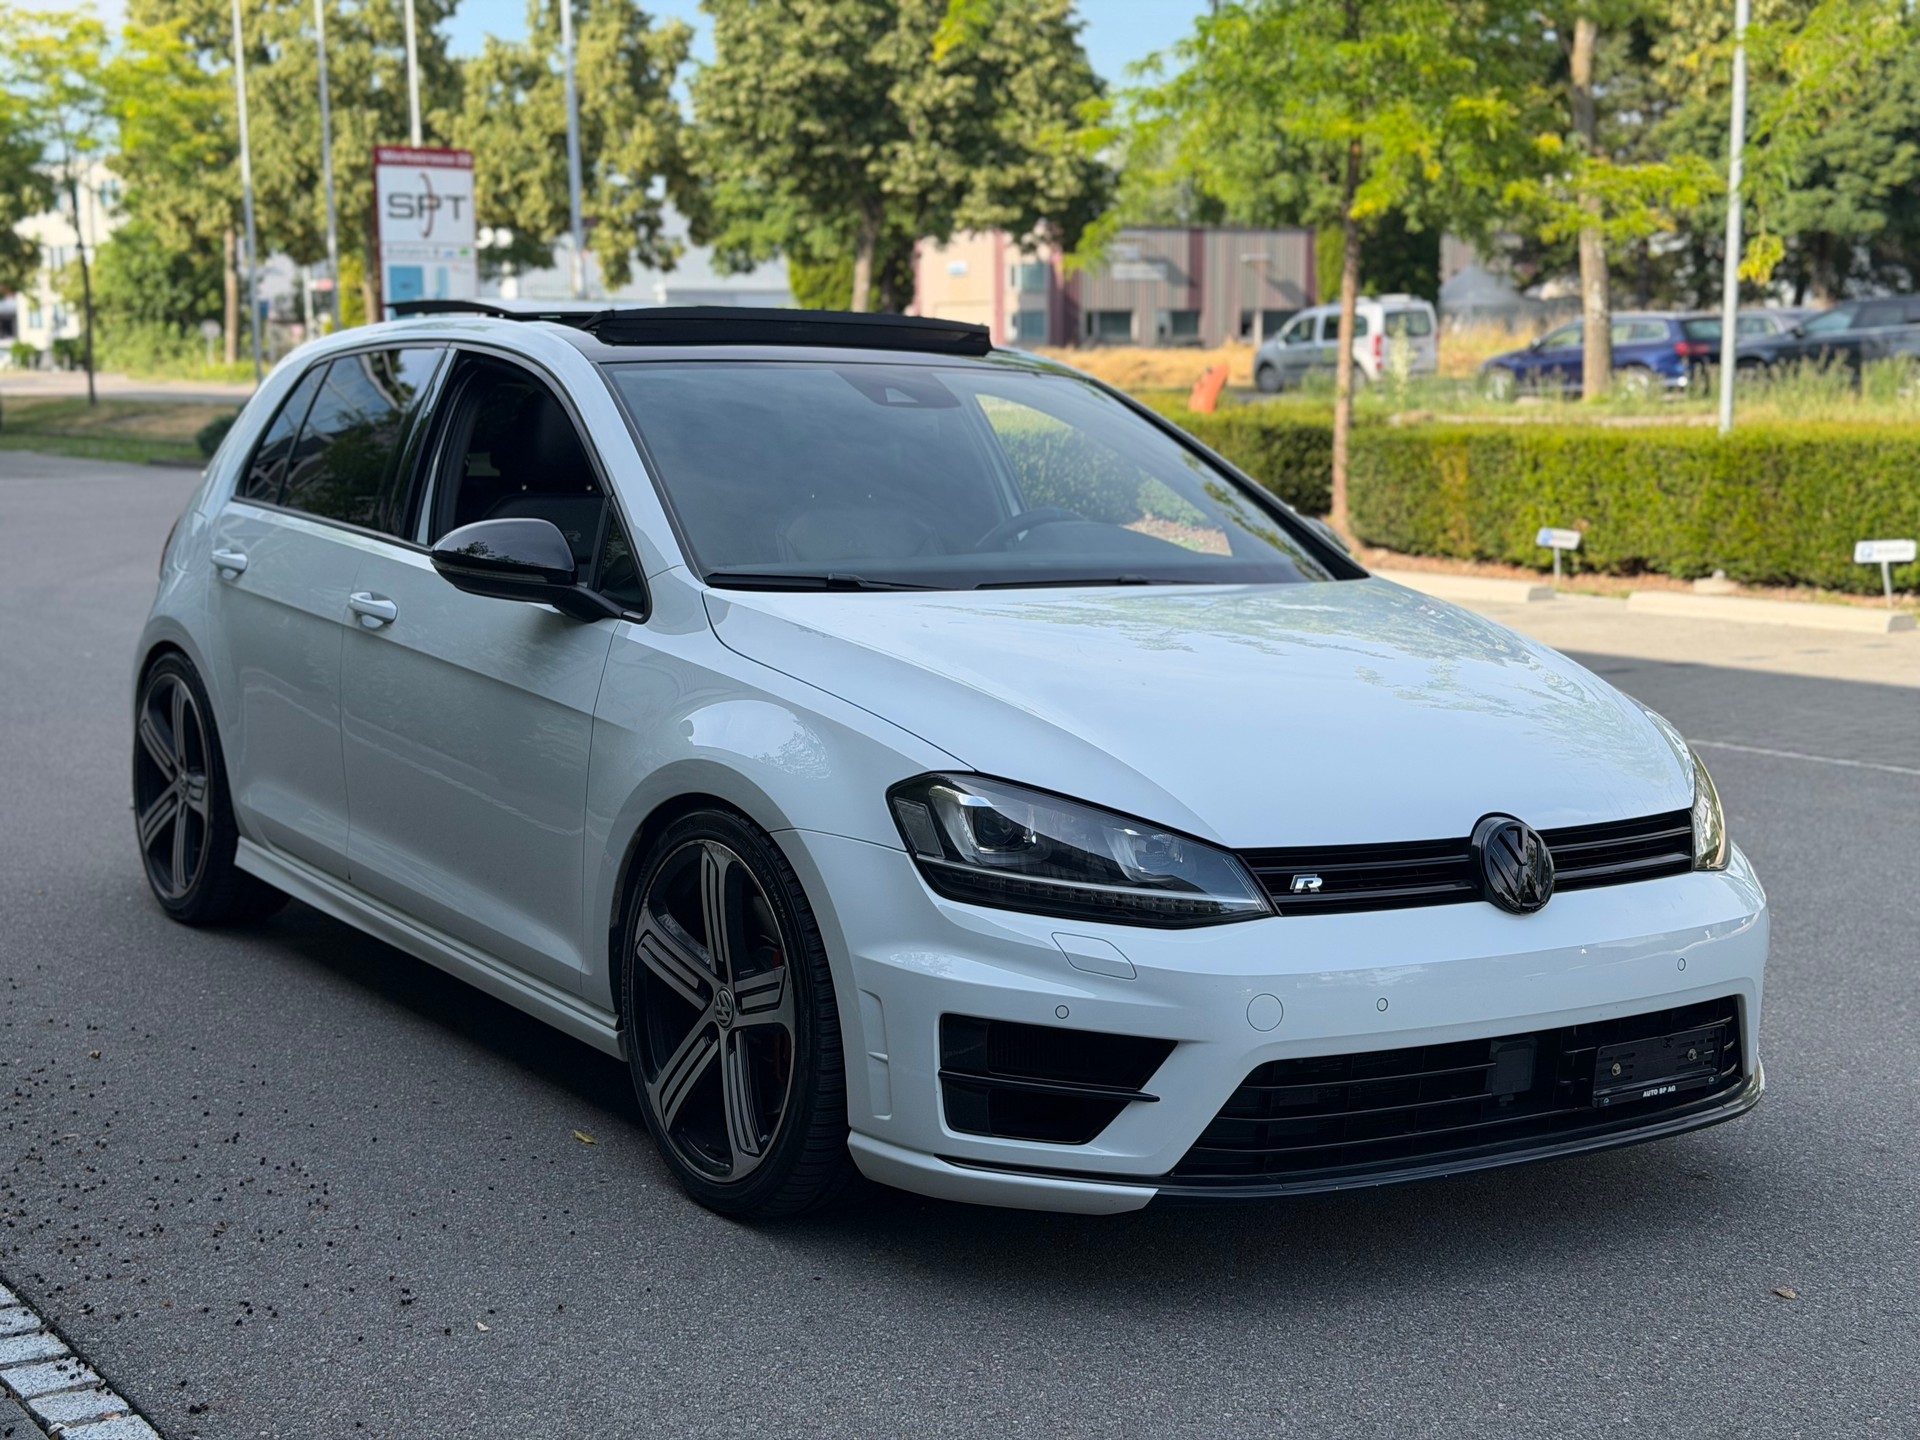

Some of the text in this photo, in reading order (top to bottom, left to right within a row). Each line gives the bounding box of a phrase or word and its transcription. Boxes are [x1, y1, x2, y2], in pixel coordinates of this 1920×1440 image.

[386, 192, 468, 221] SPT
[1291, 874, 1323, 893] R
[1642, 1088, 1659, 1097] AUTO
[1668, 1085, 1677, 1093] AG
